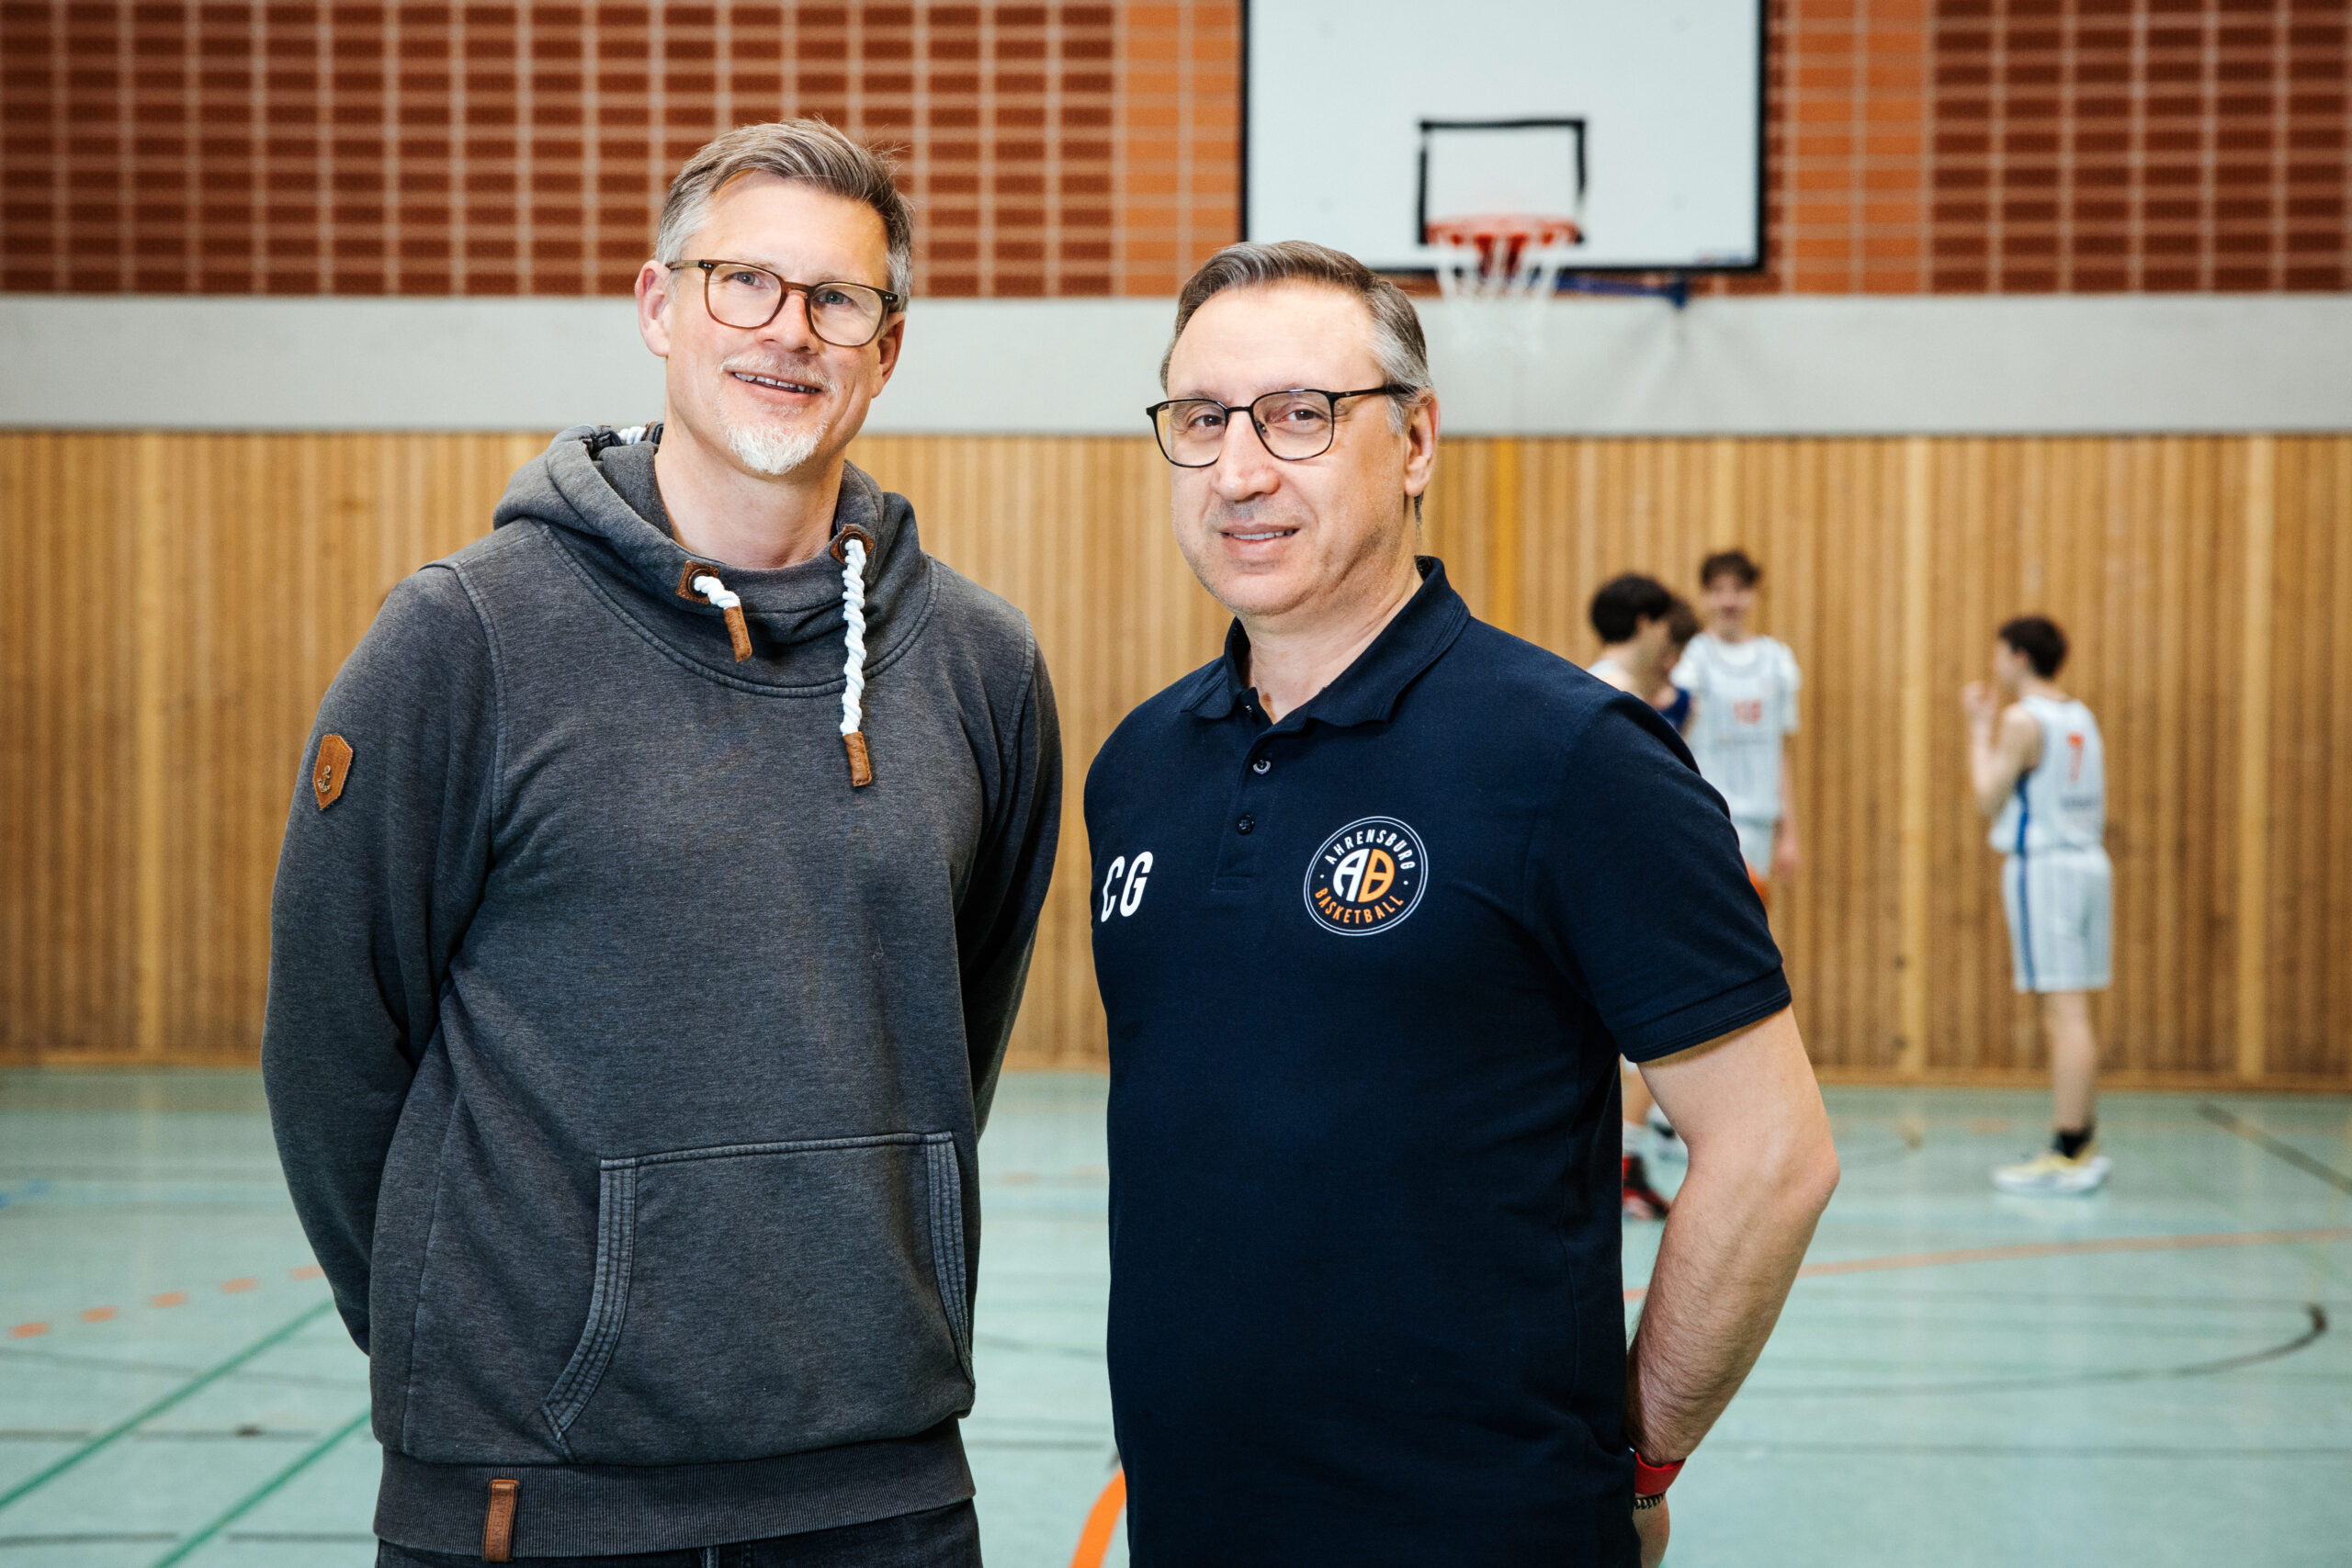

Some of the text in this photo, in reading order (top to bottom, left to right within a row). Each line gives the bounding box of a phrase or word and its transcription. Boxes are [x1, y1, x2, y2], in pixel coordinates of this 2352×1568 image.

[2066, 732, 2085, 784] 7
[1324, 829, 1416, 870] AHRENSBURG
[1101, 851, 1154, 922] CG
[1315, 887, 1404, 924] BASKETBALL
